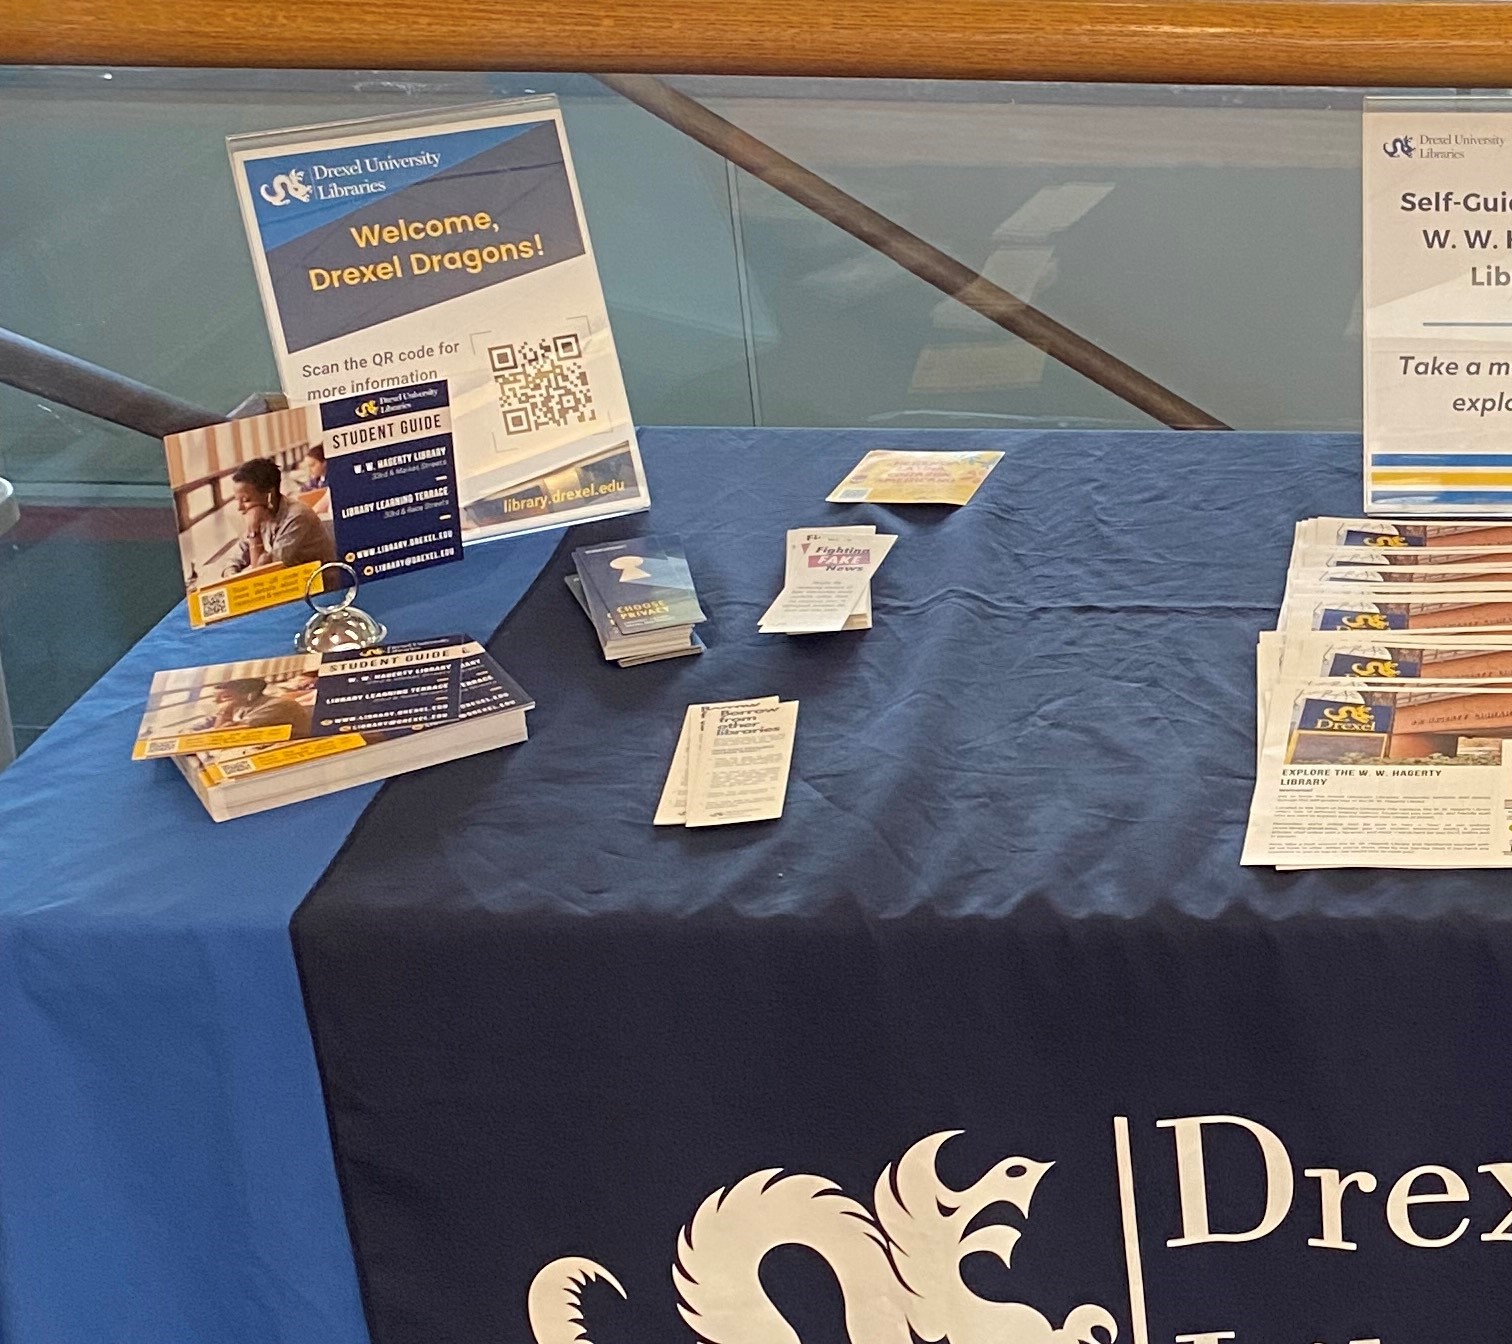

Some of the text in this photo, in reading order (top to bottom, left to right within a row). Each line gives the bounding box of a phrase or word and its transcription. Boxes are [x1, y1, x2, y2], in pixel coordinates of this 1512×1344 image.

[1420, 134, 1505, 147] Drexel University
[1420, 148, 1465, 159] Libraries
[313, 151, 441, 181] Drexel University
[317, 179, 386, 201] Libraries
[350, 209, 500, 249] Welcome,
[1423, 230, 1456, 249] W.
[1464, 230, 1497, 249] W.
[309, 234, 545, 292] Drexel Dragons!
[302, 340, 460, 378] Scan the QR code for
[1399, 356, 1458, 376] Take
[1466, 361, 1481, 376] a
[307, 367, 438, 401] more information
[333, 414, 442, 448] STUDENT GUIDE
[503, 478, 625, 514] library.drexel.edu
[817, 555, 862, 564] FAKE
[616, 599, 668, 613] CHOOSE
[620, 607, 670, 619] PRIVACY
[329, 651, 450, 672] STUDENT GUIDE
[721, 707, 779, 716] Borrow
[1315, 719, 1375, 731] Drexel
